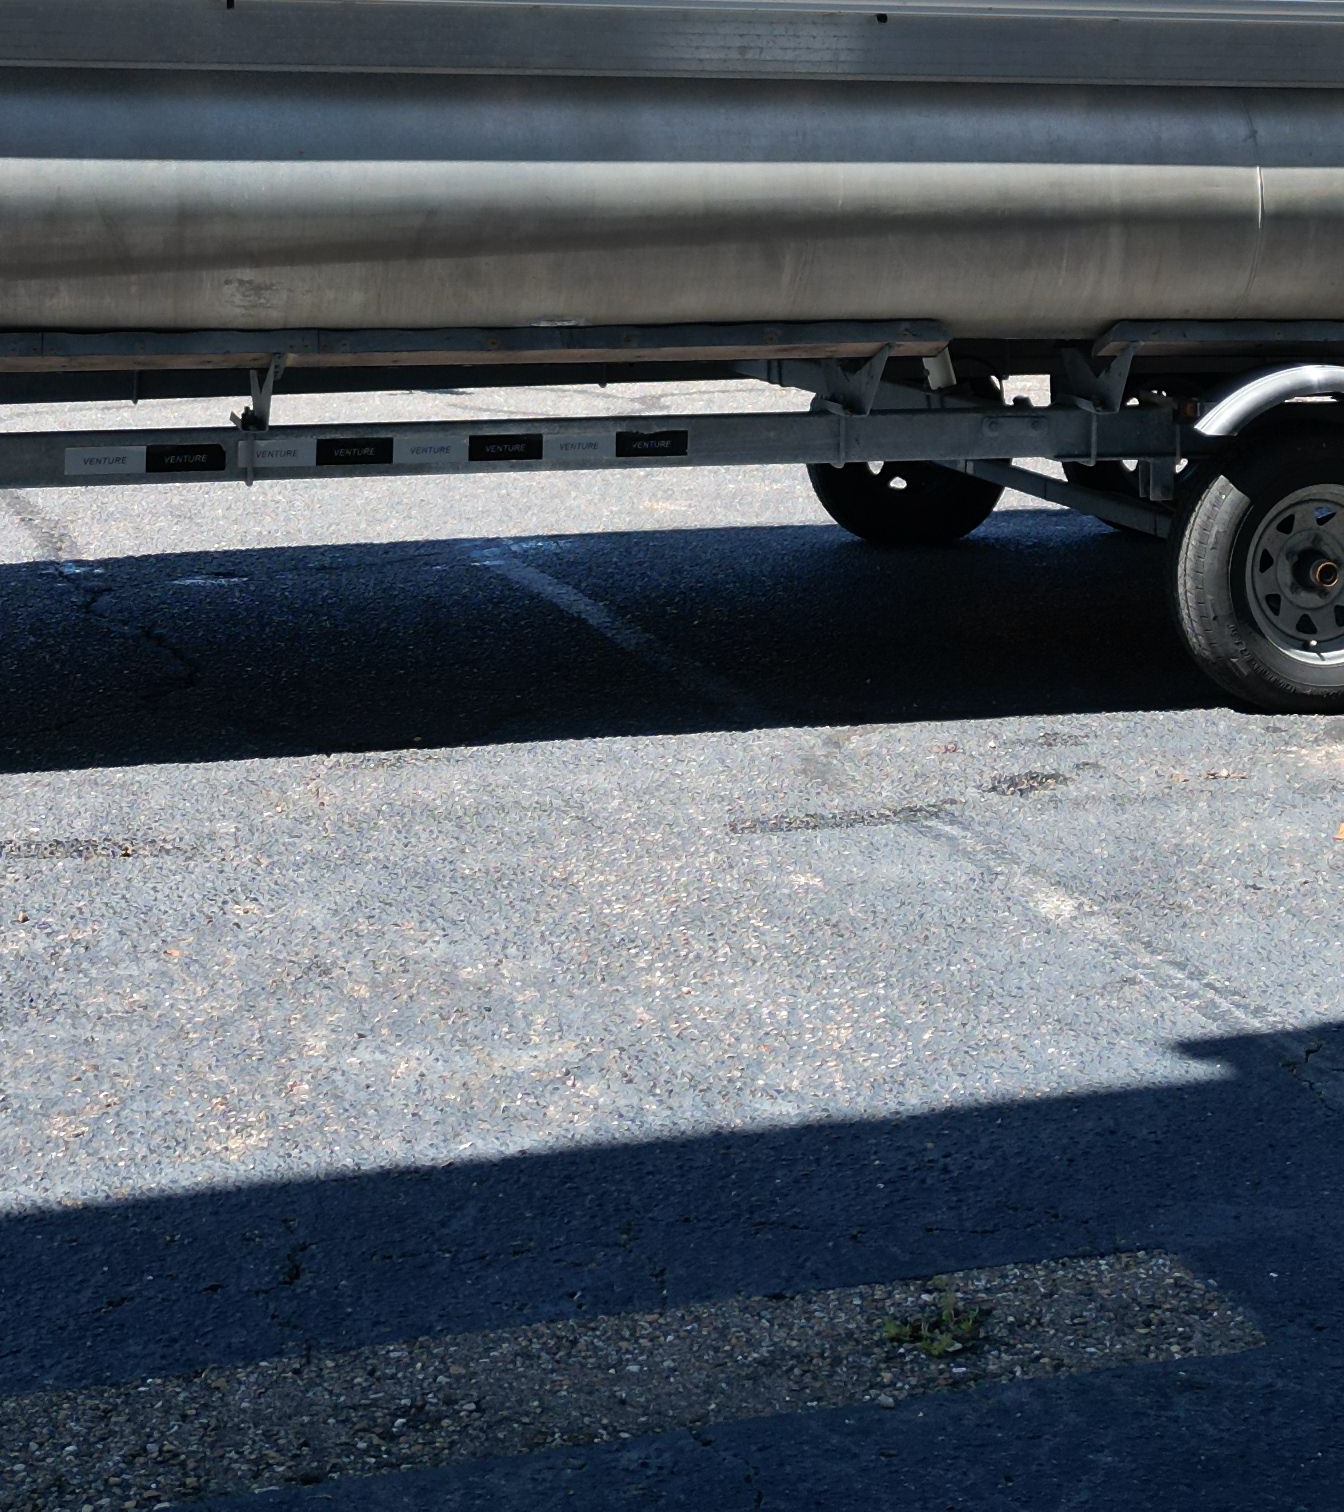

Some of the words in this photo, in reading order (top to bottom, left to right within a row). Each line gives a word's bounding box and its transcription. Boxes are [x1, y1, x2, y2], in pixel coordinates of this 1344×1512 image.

[410, 445, 451, 455] VENTURE
[485, 443, 527, 453] VENTURE
[560, 441, 599, 451] VENTURE
[256, 449, 297, 458] VENTURE
[333, 447, 375, 457] VENTURE
[83, 456, 127, 465] VENTURE
[163, 454, 207, 464] VENTURE
